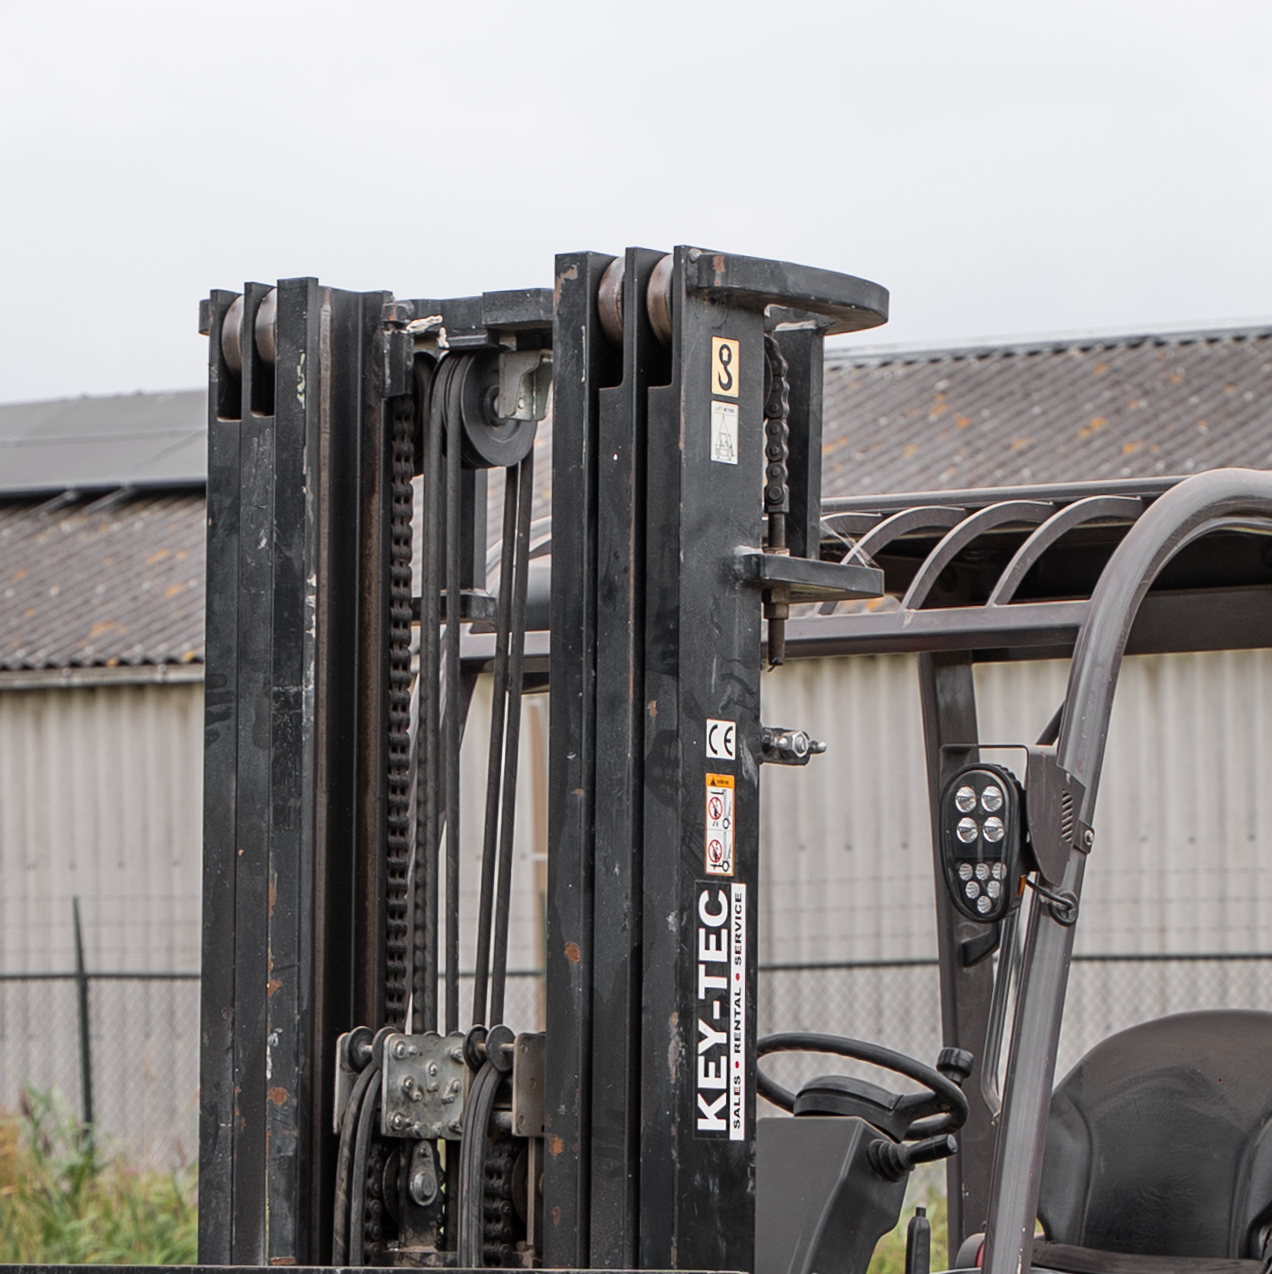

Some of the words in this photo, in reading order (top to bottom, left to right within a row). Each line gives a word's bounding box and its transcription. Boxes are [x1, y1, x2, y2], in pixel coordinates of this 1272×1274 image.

[734, 892, 742, 966] SERVICE
[697, 889, 728, 1131] KEY-TEC
[733, 987, 742, 1054] RENTAL
[733, 1075, 742, 1129] SALES
